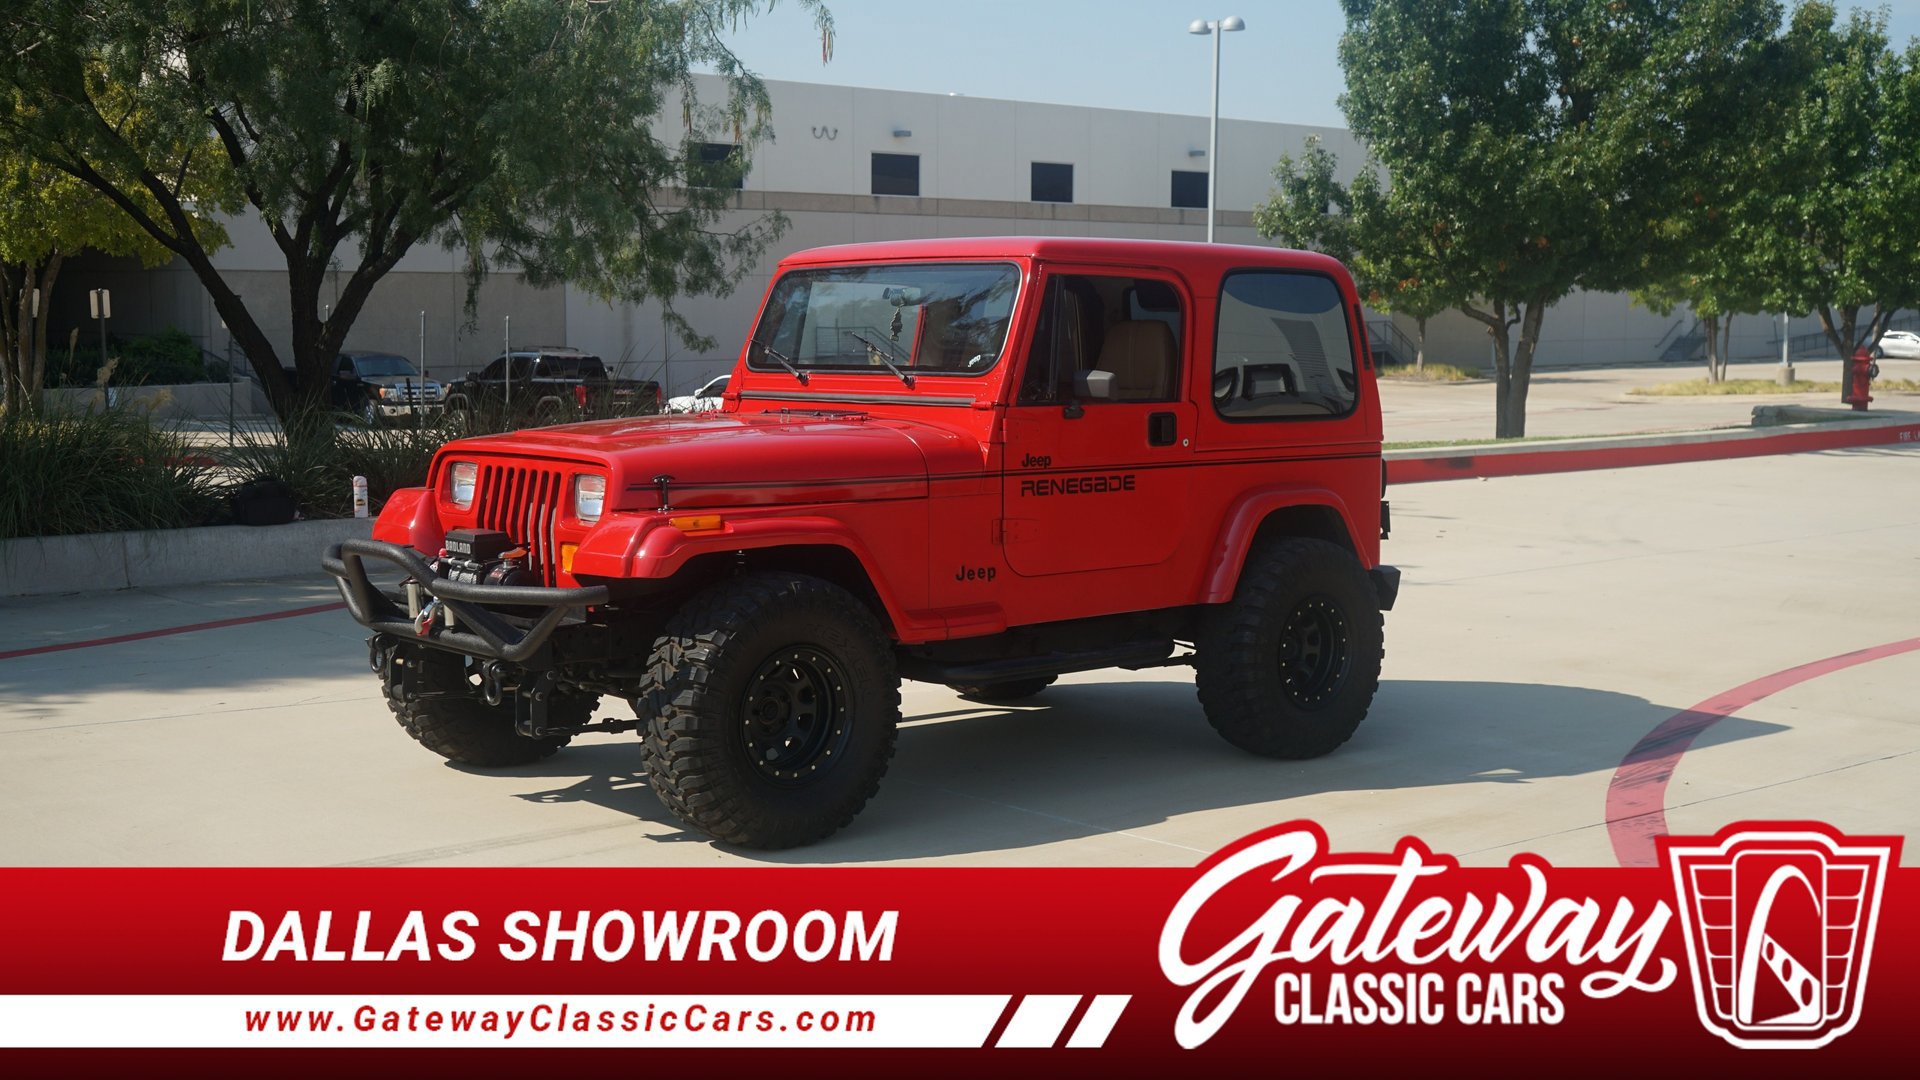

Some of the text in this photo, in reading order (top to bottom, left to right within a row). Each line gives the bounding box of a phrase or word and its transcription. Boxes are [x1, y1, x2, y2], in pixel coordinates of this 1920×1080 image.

[1022, 453, 1051, 468] Jeep
[1021, 475, 1135, 497] RENEGADE
[445, 540, 471, 554] BADLAND
[955, 565, 996, 582] Jeep
